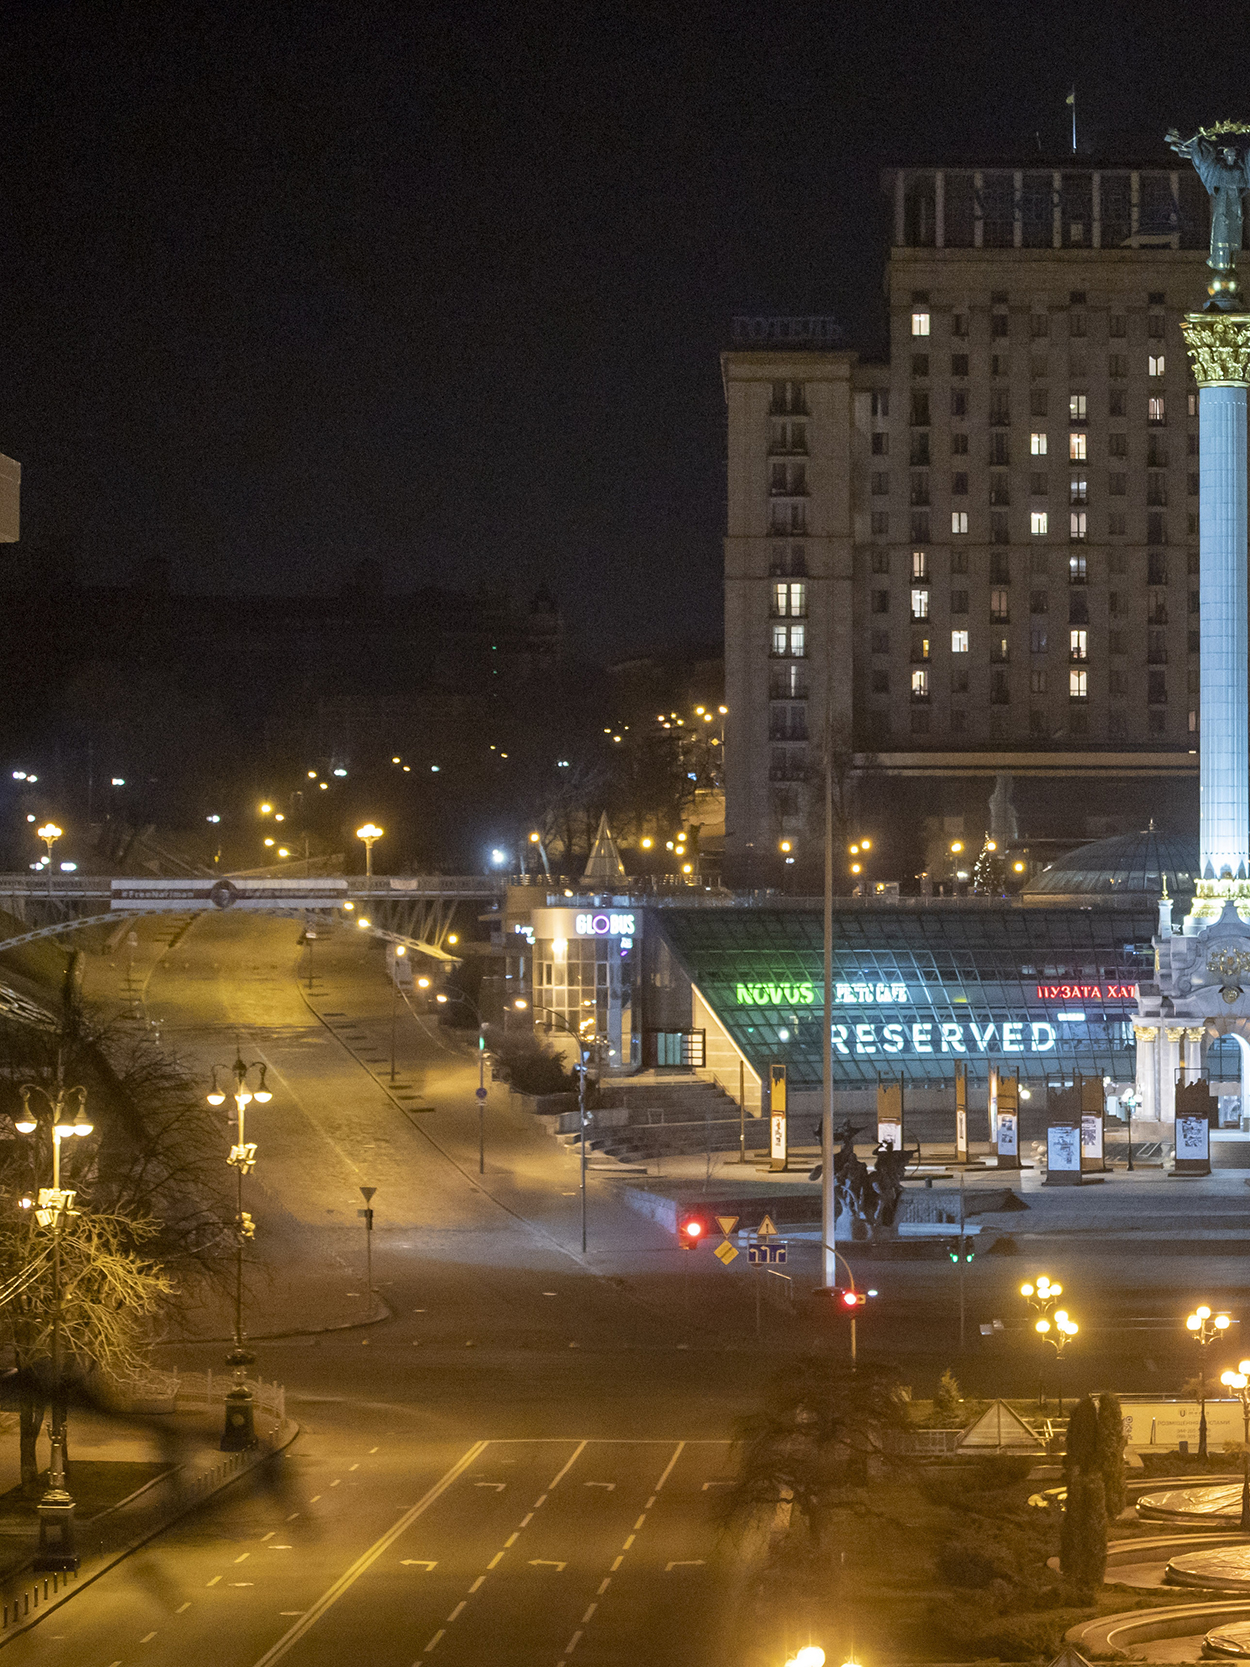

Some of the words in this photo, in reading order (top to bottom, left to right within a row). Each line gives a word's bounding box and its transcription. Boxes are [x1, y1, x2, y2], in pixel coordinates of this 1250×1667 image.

[731, 316, 842, 339] ГОТЕЛЬ
[576, 914, 635, 935] GLOBUS
[737, 983, 814, 1005] NOVUS
[1037, 985, 1102, 999] ПУЗАТА
[1107, 985, 1136, 999] ХАТ
[831, 1023, 1056, 1054] RESERVED
